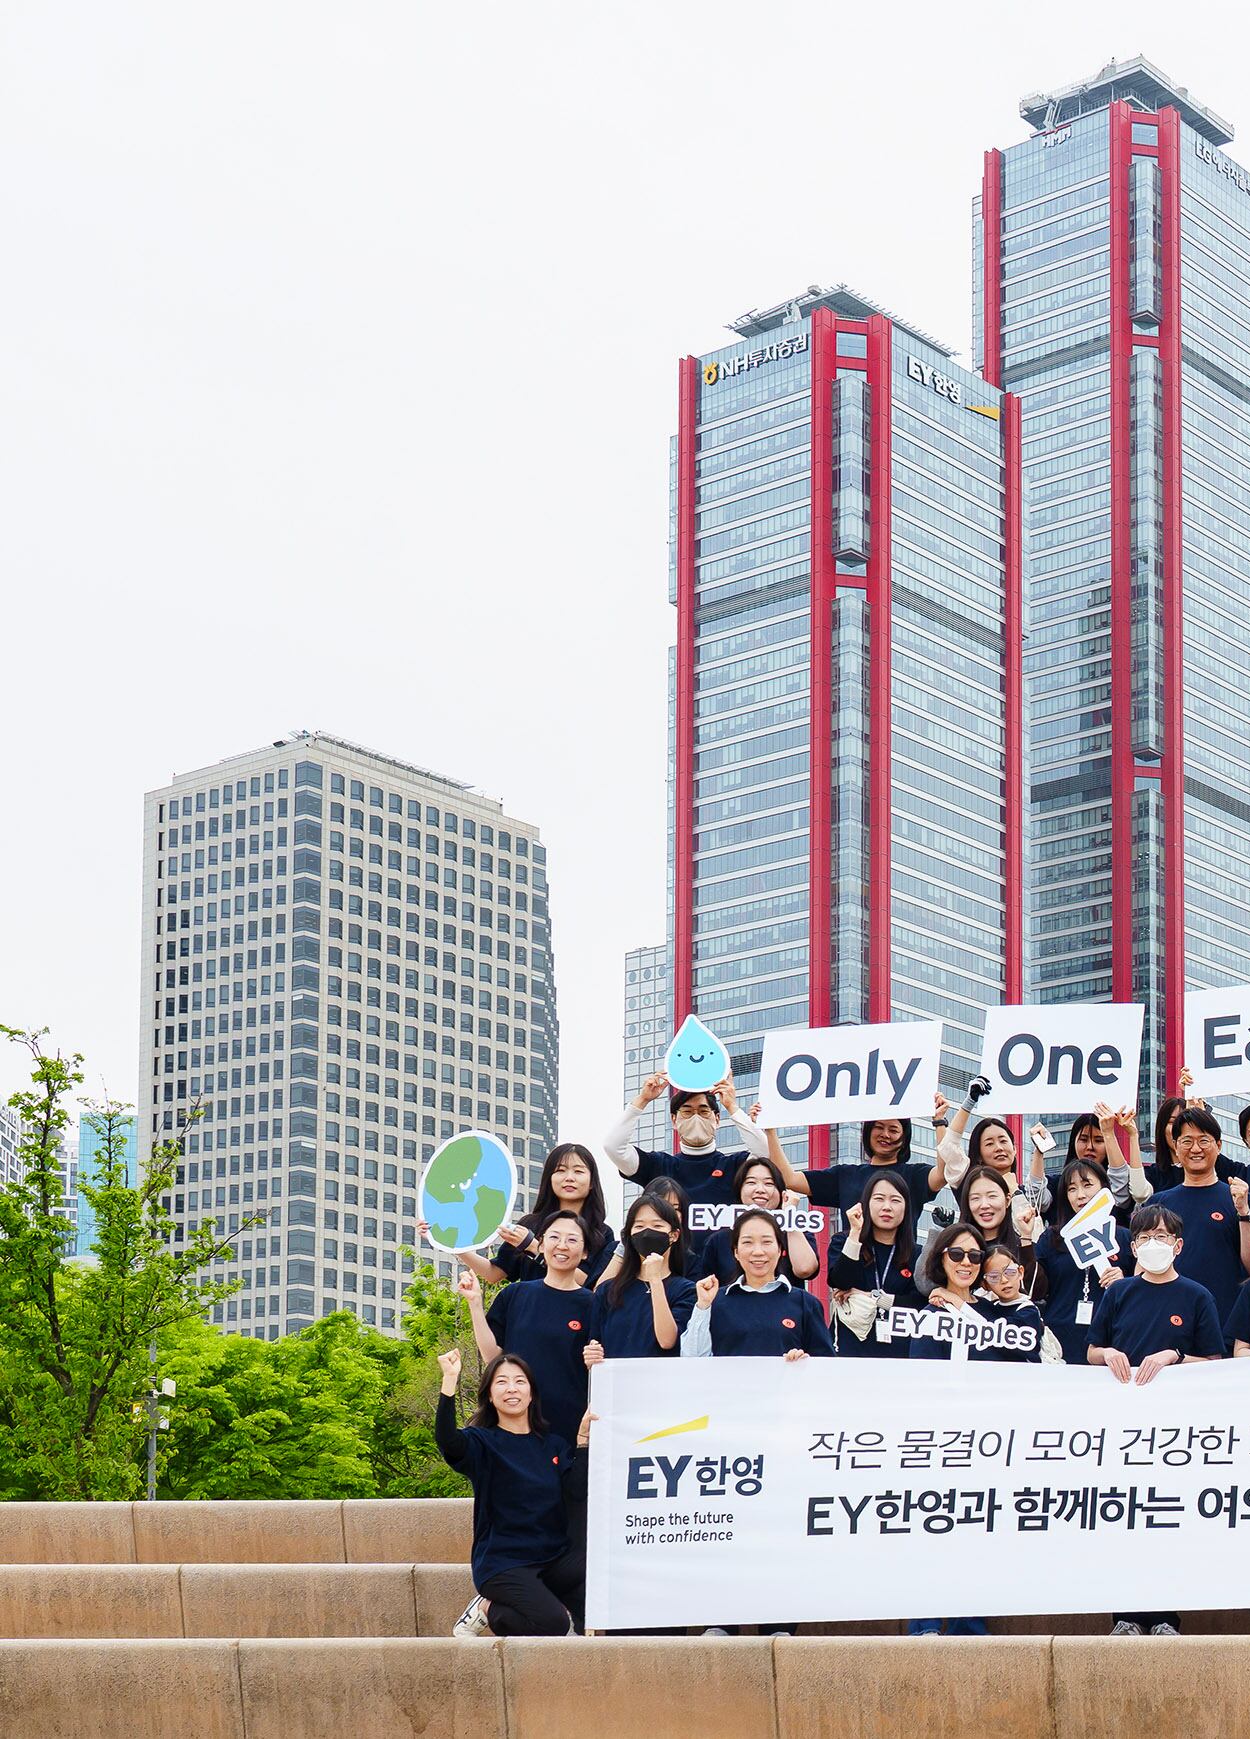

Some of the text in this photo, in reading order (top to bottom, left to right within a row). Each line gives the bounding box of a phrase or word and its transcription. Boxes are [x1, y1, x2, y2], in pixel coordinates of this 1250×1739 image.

[720, 333, 808, 380] NH투자증권
[907, 356, 961, 405] EY한영
[776, 1048, 921, 1105] Only
[997, 1034, 1122, 1086] One
[692, 1208, 723, 1227] EY
[1070, 1221, 1115, 1263] EY
[892, 1311, 1033, 1347] EY Ripples
[808, 1432, 886, 1470] 작은
[898, 1430, 1015, 1468] 물결이
[1026, 1428, 1105, 1466] 모여
[1119, 1425, 1240, 1466] 건강한
[627, 1455, 764, 1499] EY한영
[625, 1511, 734, 1529] Shape the future
[807, 1488, 1002, 1535] EY한영과
[1014, 1487, 1184, 1531] 함께하는
[625, 1530, 733, 1544] with confidence
